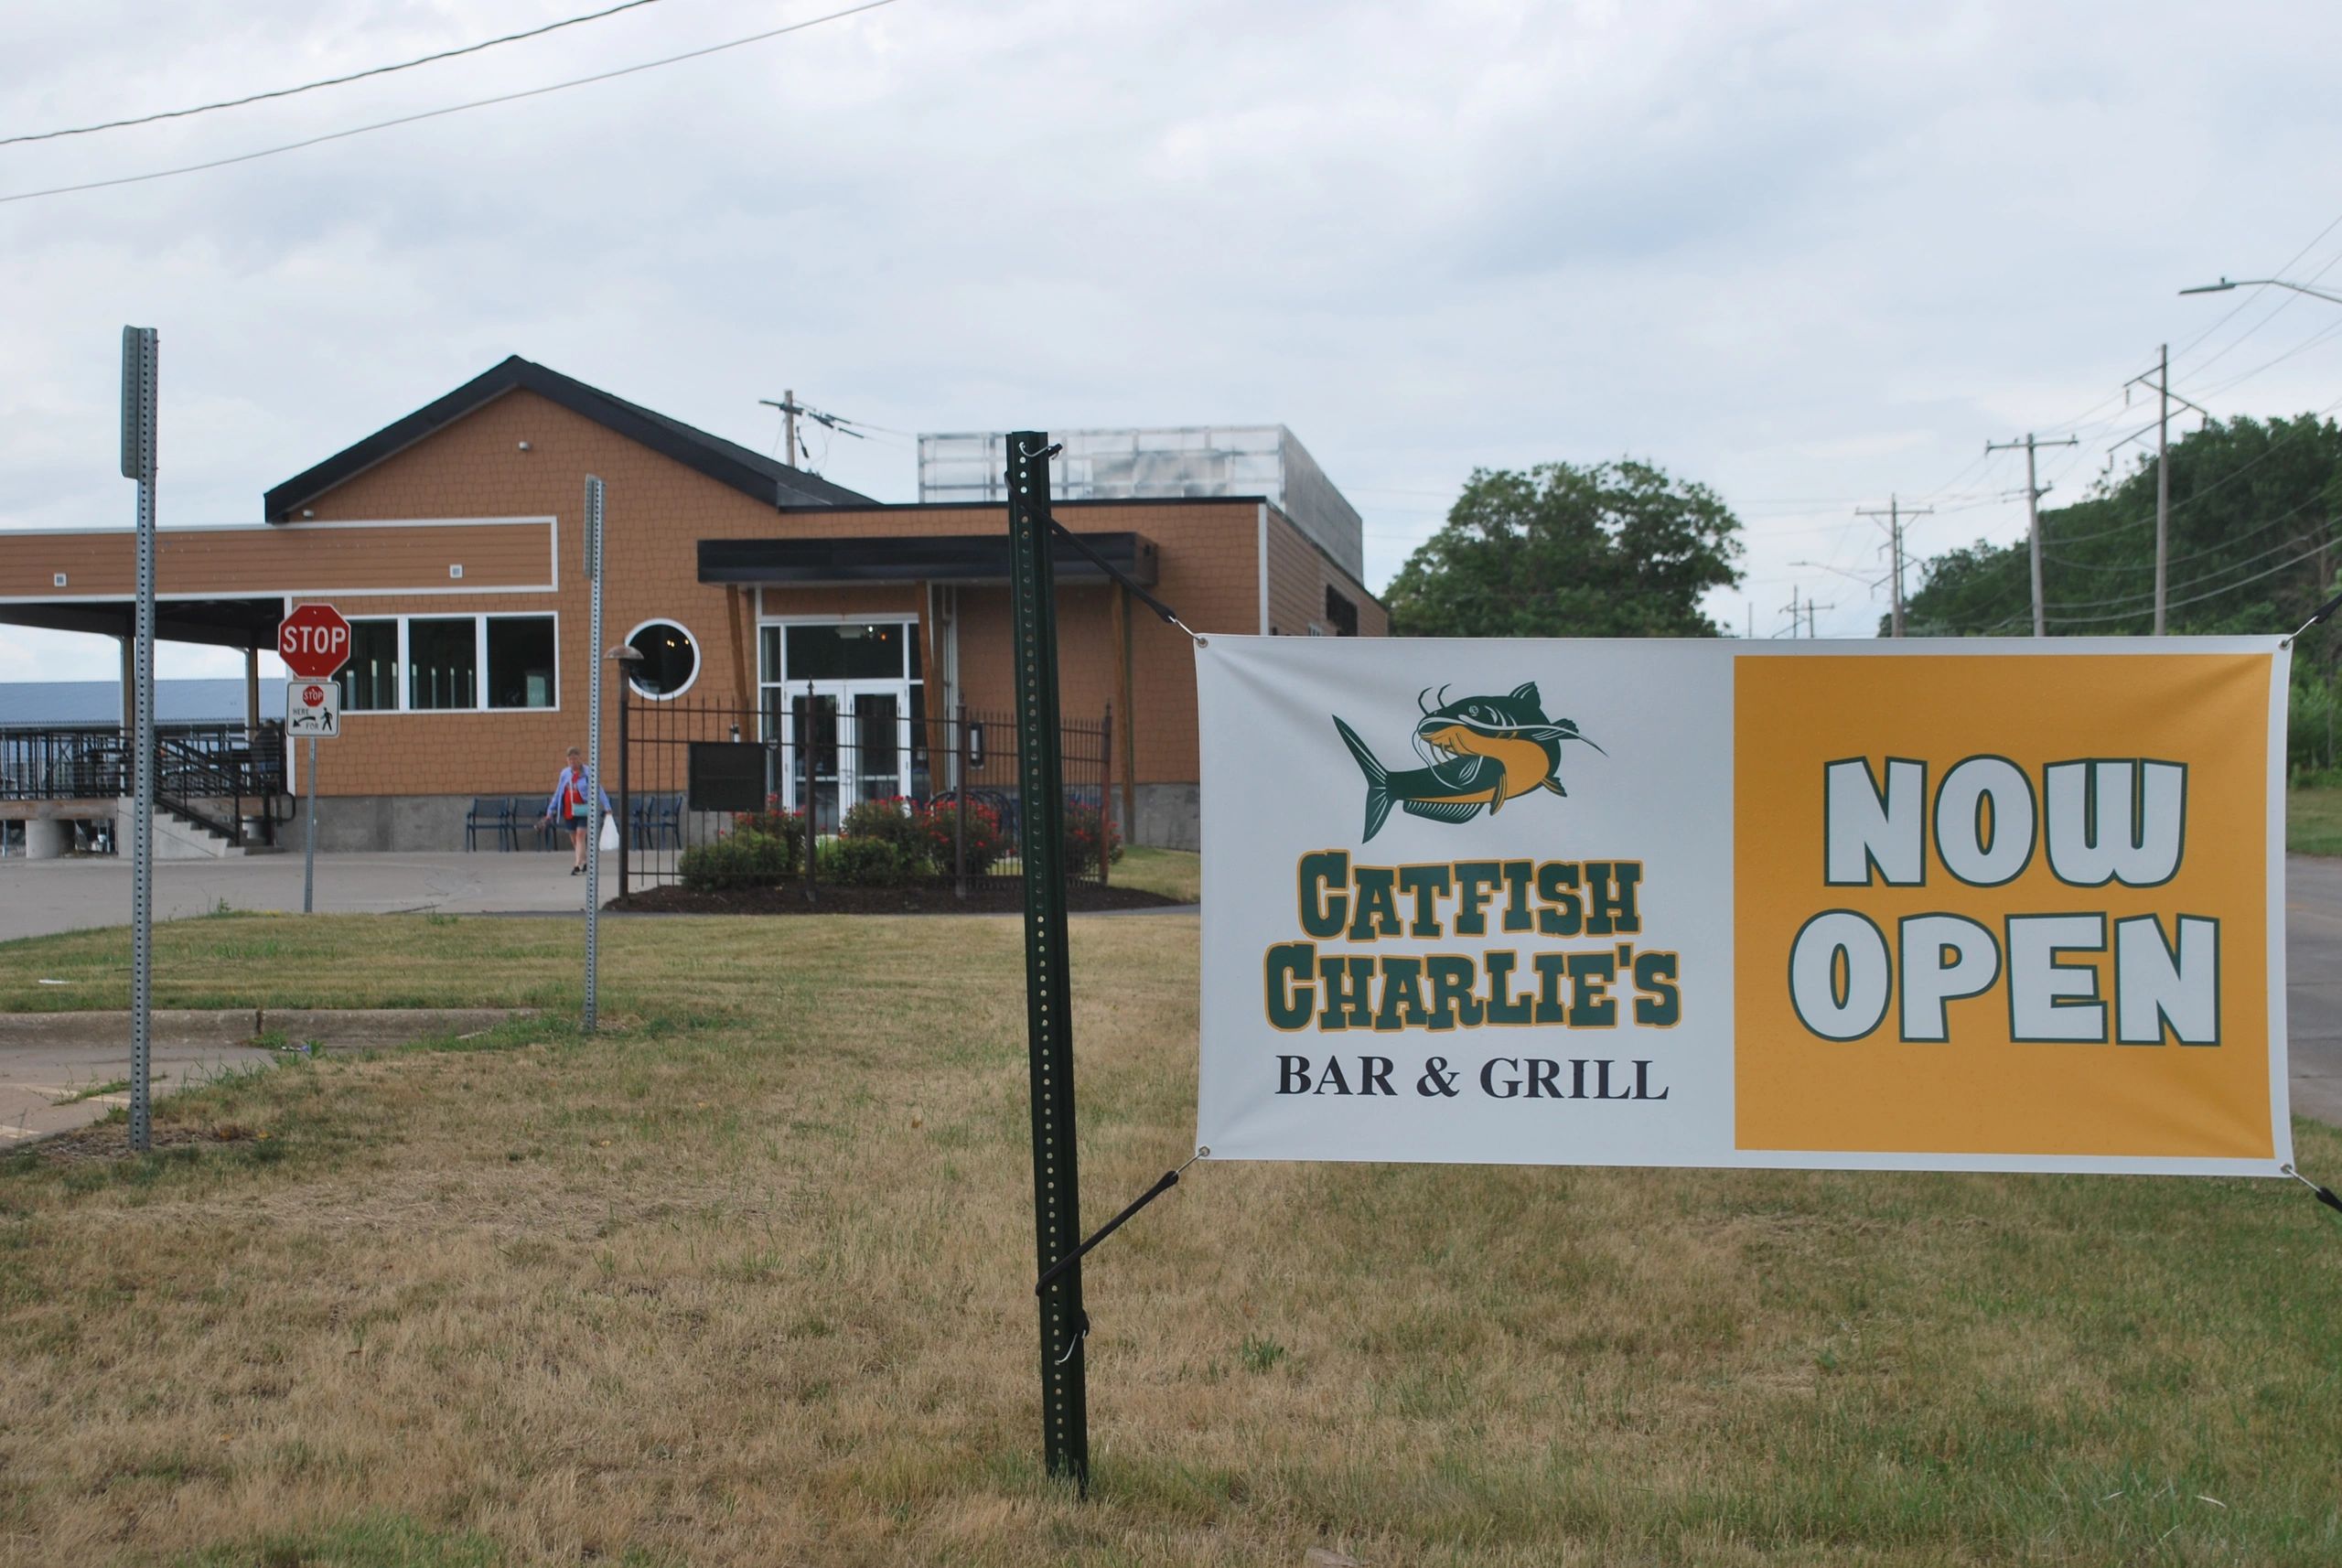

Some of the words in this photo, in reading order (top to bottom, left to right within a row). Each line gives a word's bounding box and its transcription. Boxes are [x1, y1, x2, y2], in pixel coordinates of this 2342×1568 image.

[283, 626, 346, 654] STOP
[303, 690, 324, 702] STOP
[1823, 753, 2188, 888] NOW
[1296, 849, 1643, 943] CATFISH
[1263, 941, 1682, 1034] CHARLIE'S
[1788, 908, 2221, 1047] OPEN
[1274, 1055, 1398, 1097] BAR
[1416, 1055, 1460, 1098] &
[1479, 1057, 1670, 1101] GRILL
